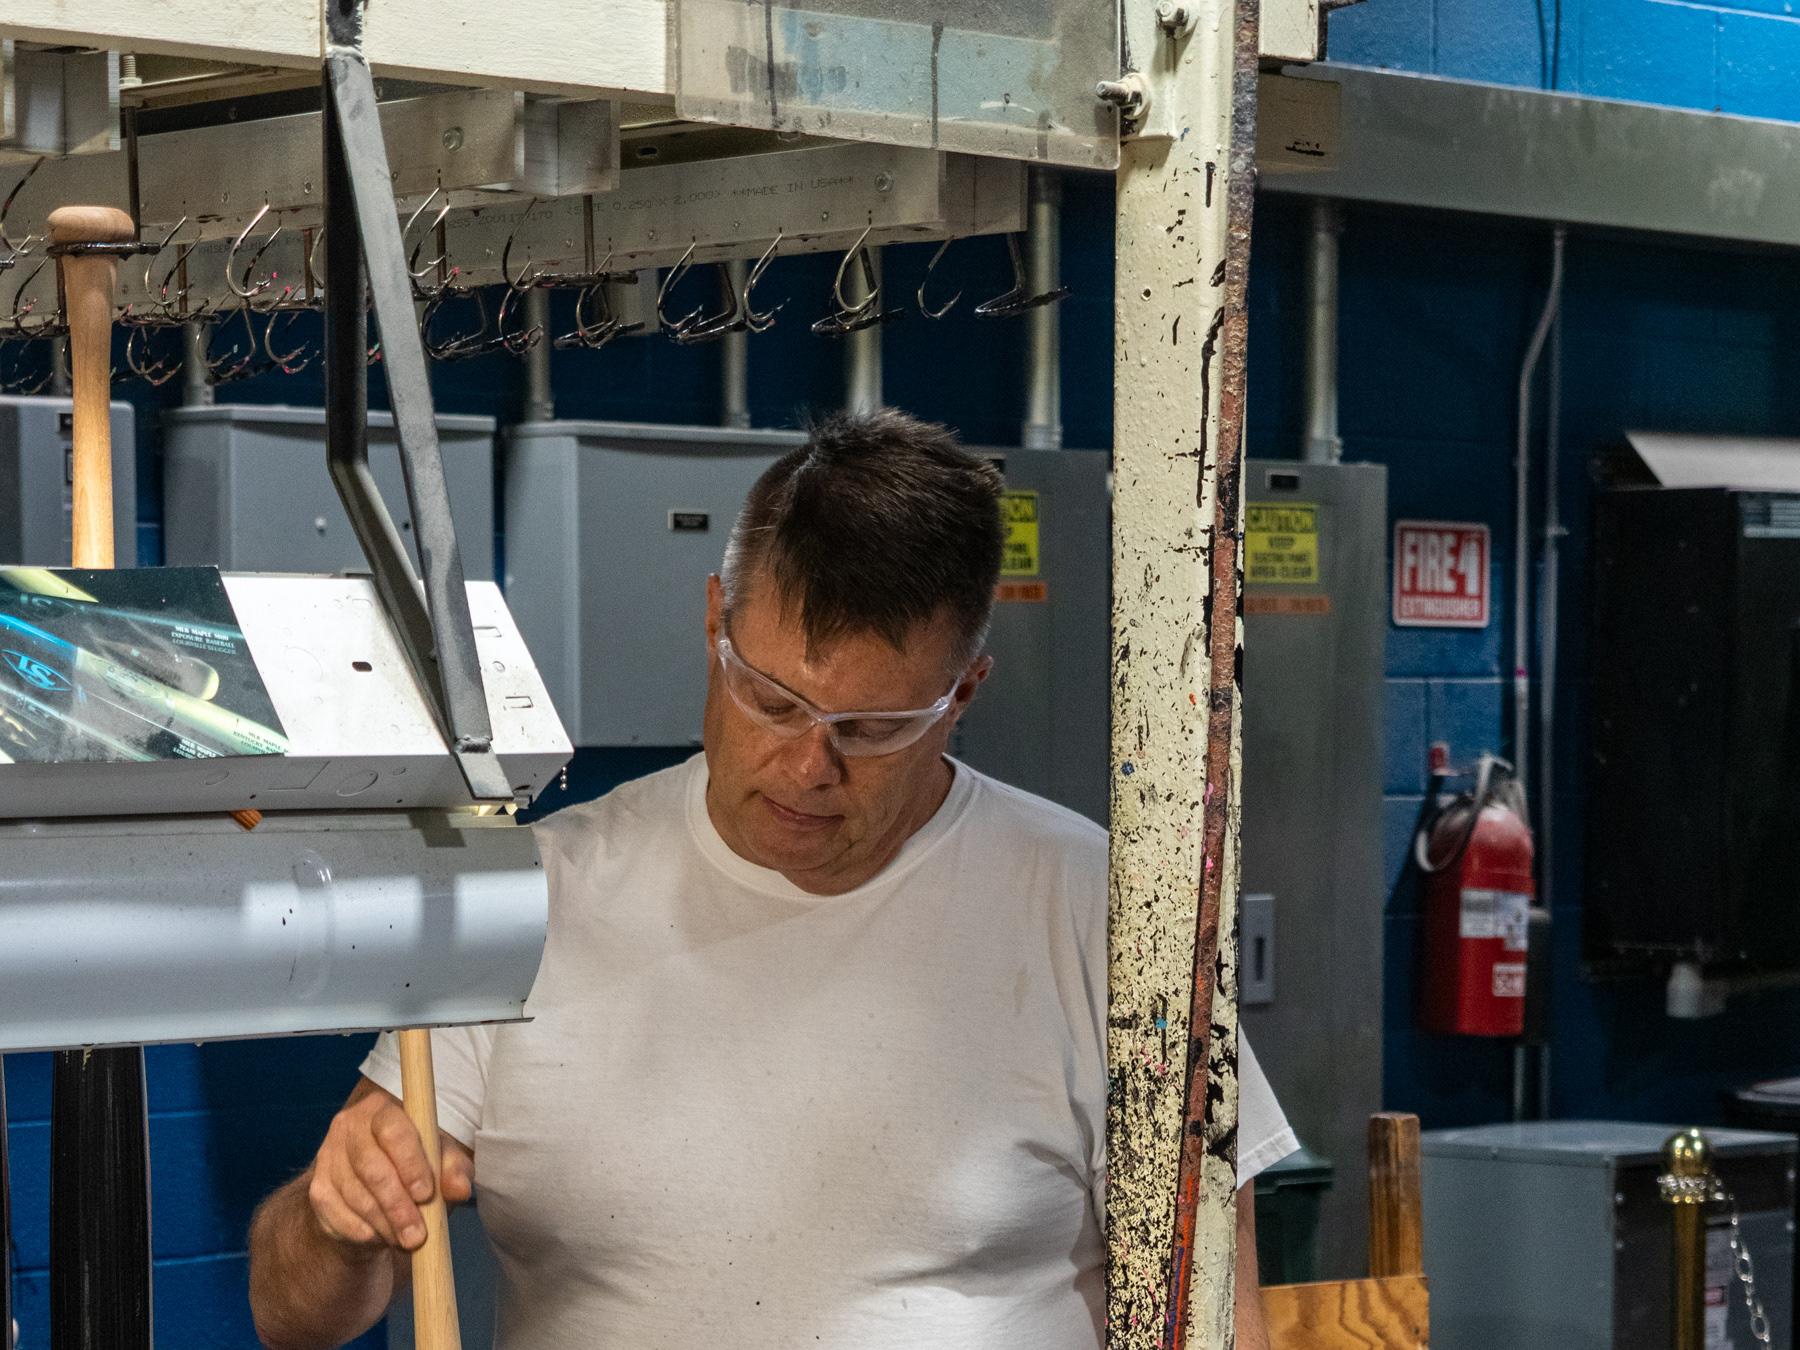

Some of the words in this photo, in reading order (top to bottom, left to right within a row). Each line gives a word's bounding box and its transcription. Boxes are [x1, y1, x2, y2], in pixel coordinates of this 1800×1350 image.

[788, 181, 804, 193] IN
[1402, 531, 1457, 593] FIRE
[1401, 598, 1479, 617] EXTINGUISHER
[205, 637, 235, 649] BASEBALL
